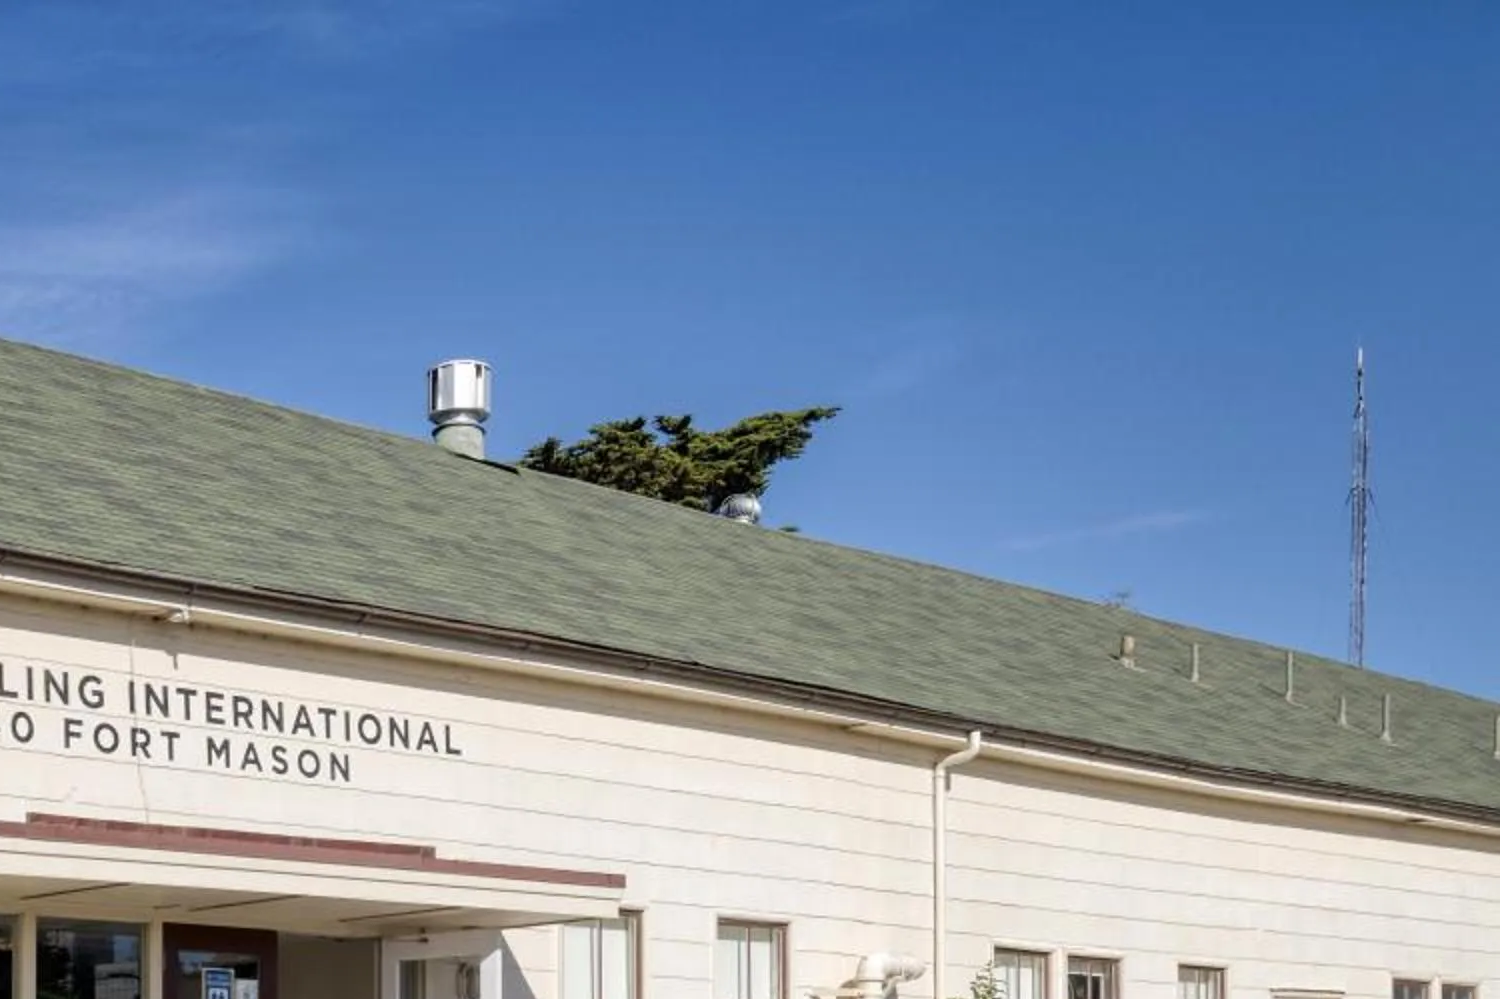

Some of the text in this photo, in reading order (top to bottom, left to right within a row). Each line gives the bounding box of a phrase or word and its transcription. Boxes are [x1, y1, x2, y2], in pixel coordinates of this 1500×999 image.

[64, 718, 181, 761] FORT
[207, 737, 350, 782] MASON
[128, 681, 462, 755] INTERNATIONAL
